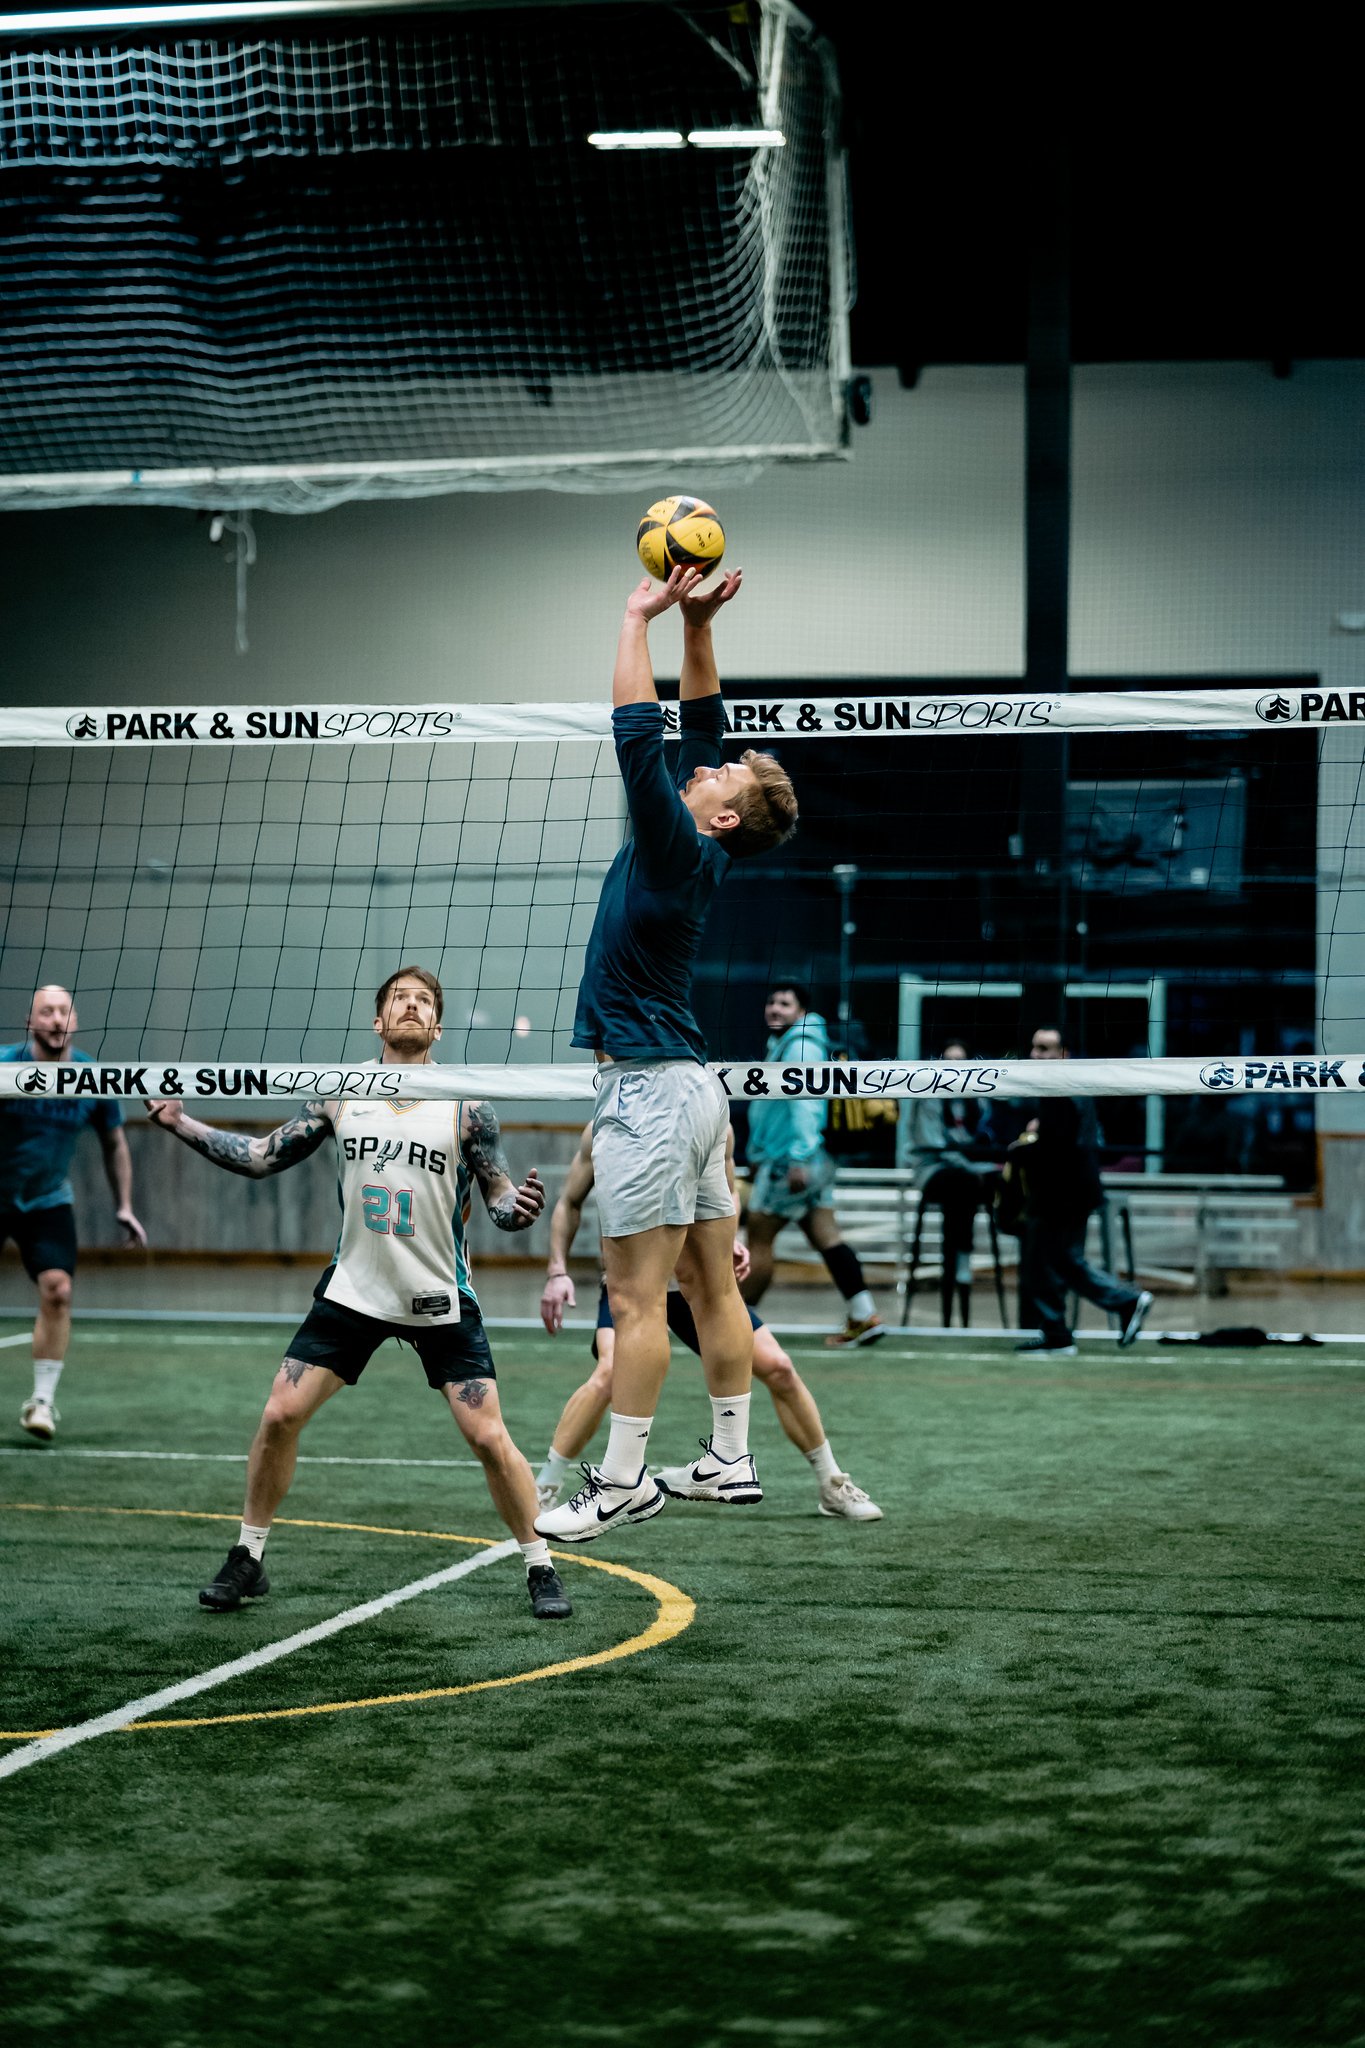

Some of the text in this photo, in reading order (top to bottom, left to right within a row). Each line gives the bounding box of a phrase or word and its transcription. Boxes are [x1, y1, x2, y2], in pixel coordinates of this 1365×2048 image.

[106, 711, 454, 740] PARK & SUN SPORTS
[723, 701, 1052, 732] RK & SUN SPORTS
[56, 1067, 402, 1097] PARK & SUN SPORTS
[742, 1067, 771, 1096] &
[780, 1067, 858, 1095] SUN
[858, 1067, 999, 1094] SPORTS
[1244, 1060, 1347, 1089] PARK
[343, 1136, 447, 1176] SPURS
[361, 1183, 415, 1237] 21
